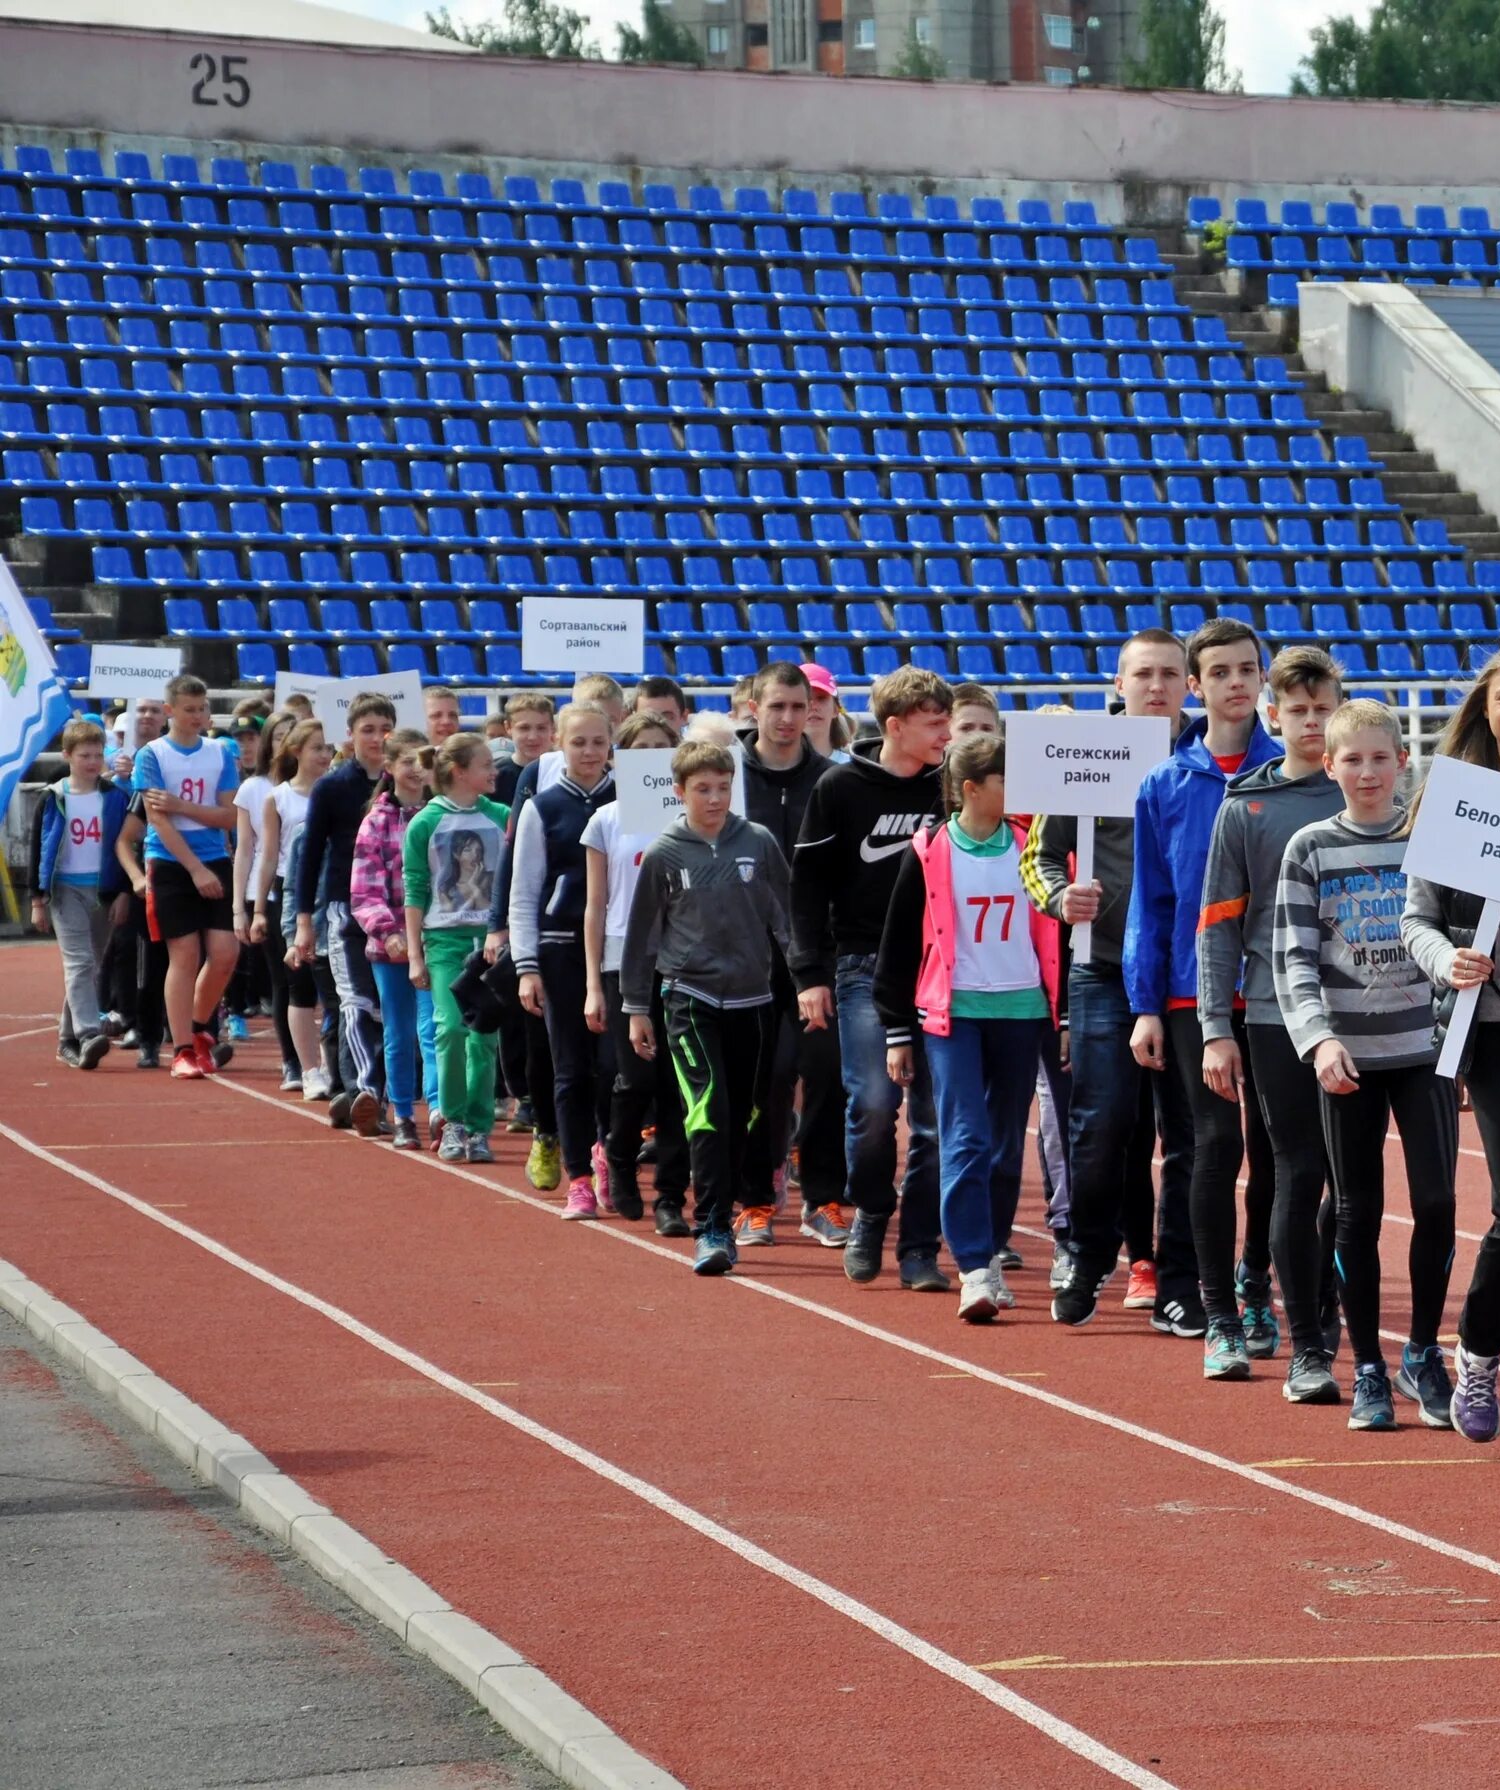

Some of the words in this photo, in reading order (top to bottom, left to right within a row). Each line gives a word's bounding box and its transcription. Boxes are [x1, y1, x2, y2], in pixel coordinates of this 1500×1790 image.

[190, 53, 250, 108] 25
[539, 619, 628, 633] Сортавальский
[566, 636, 600, 650] район
[94, 665, 175, 680] ПЕТРОЗАВОДСК
[1045, 743, 1130, 761] Сегежский
[1063, 768, 1111, 785] район
[180, 778, 205, 805] 81
[70, 816, 100, 845] 94
[869, 813, 936, 836] NIKE
[1379, 869, 1407, 893] jus
[966, 895, 1015, 943] 77
[1353, 947, 1367, 966] of
